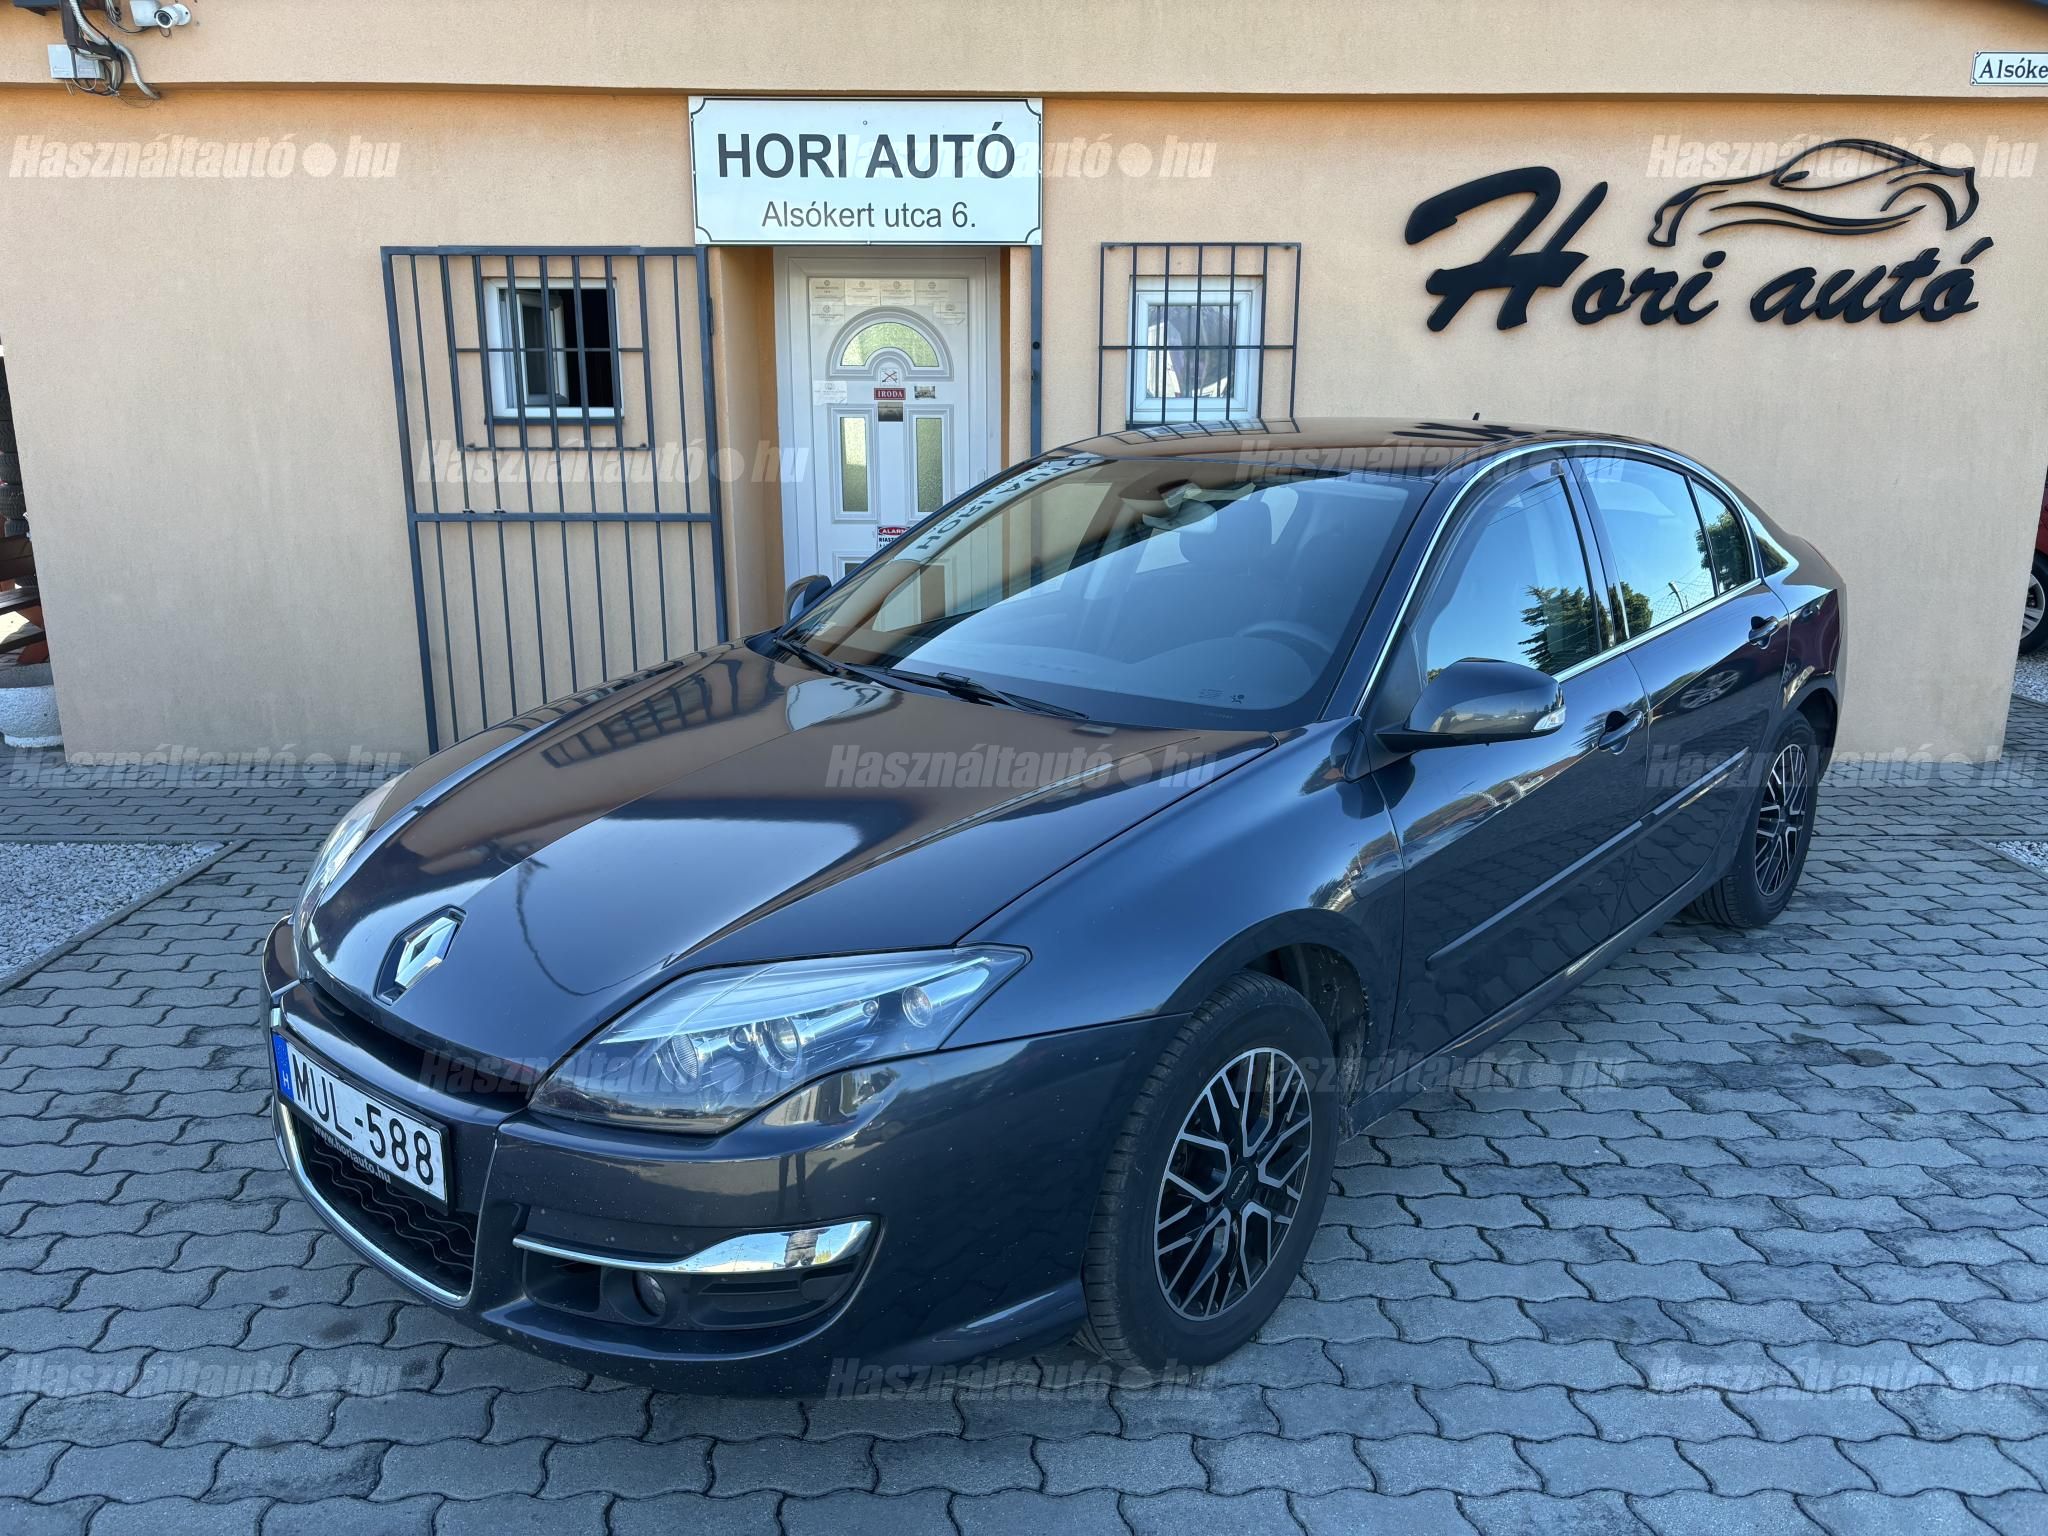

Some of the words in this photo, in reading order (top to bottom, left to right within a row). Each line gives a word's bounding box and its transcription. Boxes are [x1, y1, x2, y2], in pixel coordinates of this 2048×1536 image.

[717, 132, 846, 178] HORI
[865, 121, 1016, 179] AUTÓ
[761, 200, 874, 228] Alsókert
[884, 203, 942, 228] utca
[951, 202, 976, 228] 6.
[1404, 166, 1726, 332] Hori
[1750, 237, 1994, 326] autó
[877, 390, 903, 398] IRODA
[292, 1053, 434, 1186] MUL-588
